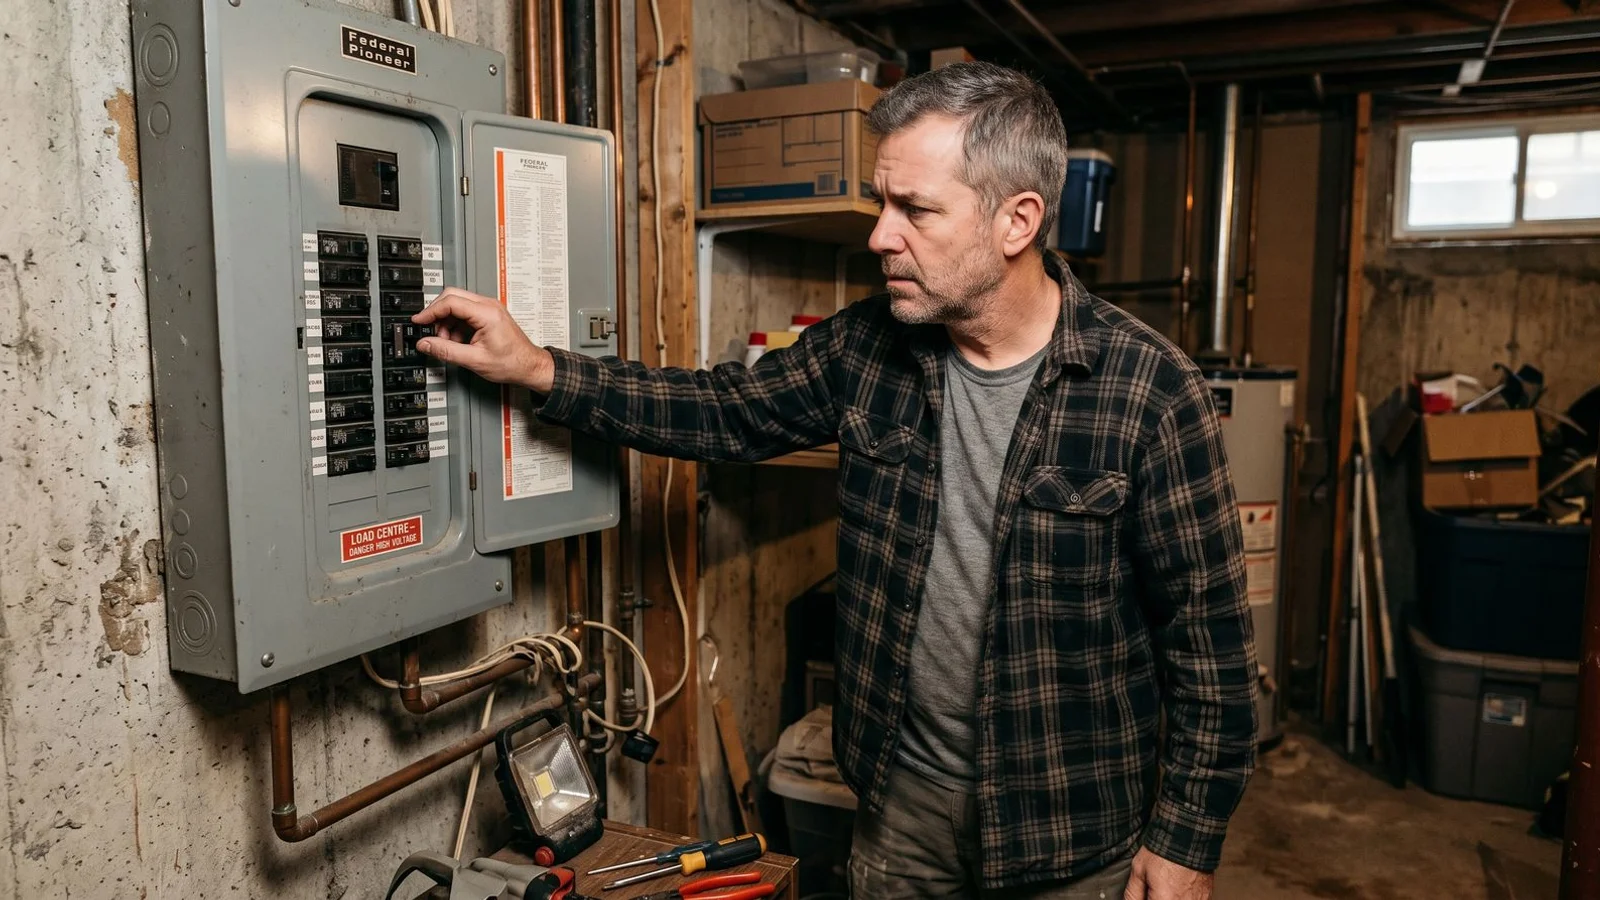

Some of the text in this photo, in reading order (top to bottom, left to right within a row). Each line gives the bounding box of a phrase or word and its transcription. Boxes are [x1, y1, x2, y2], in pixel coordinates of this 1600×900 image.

[348, 31, 410, 58] Federal
[349, 43, 411, 69] Pioneer
[349, 533, 418, 557] DANGER HIGH VOLTAGE
[351, 530, 375, 546] LOAD
